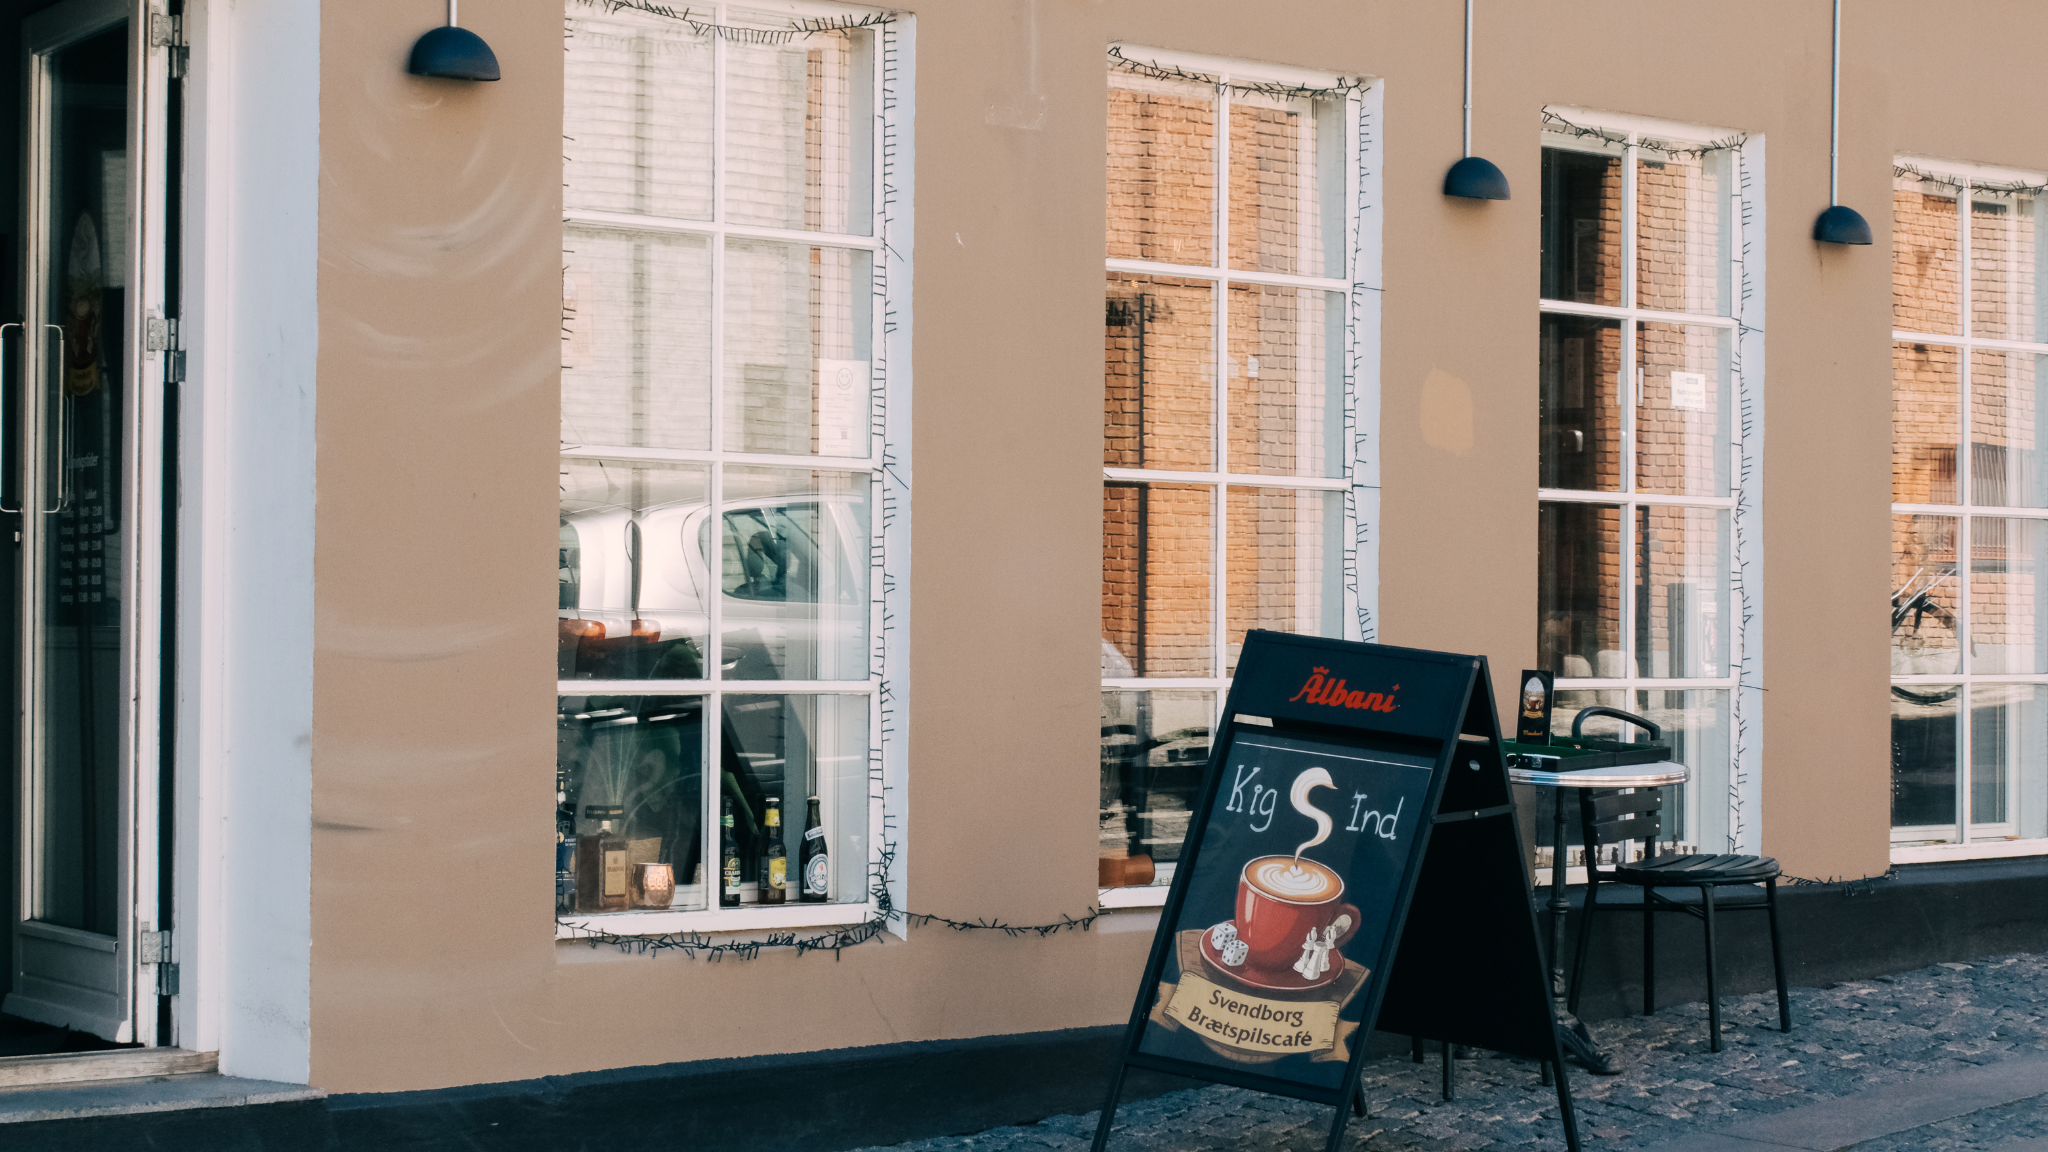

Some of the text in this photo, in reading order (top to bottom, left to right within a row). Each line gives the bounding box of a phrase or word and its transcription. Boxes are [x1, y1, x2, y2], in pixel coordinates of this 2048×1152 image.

[1226, 764, 1405, 841] Kig Ind
[1187, 1005, 1313, 1047] Brætspilscafé
[1208, 989, 1304, 1028] Svendborg
